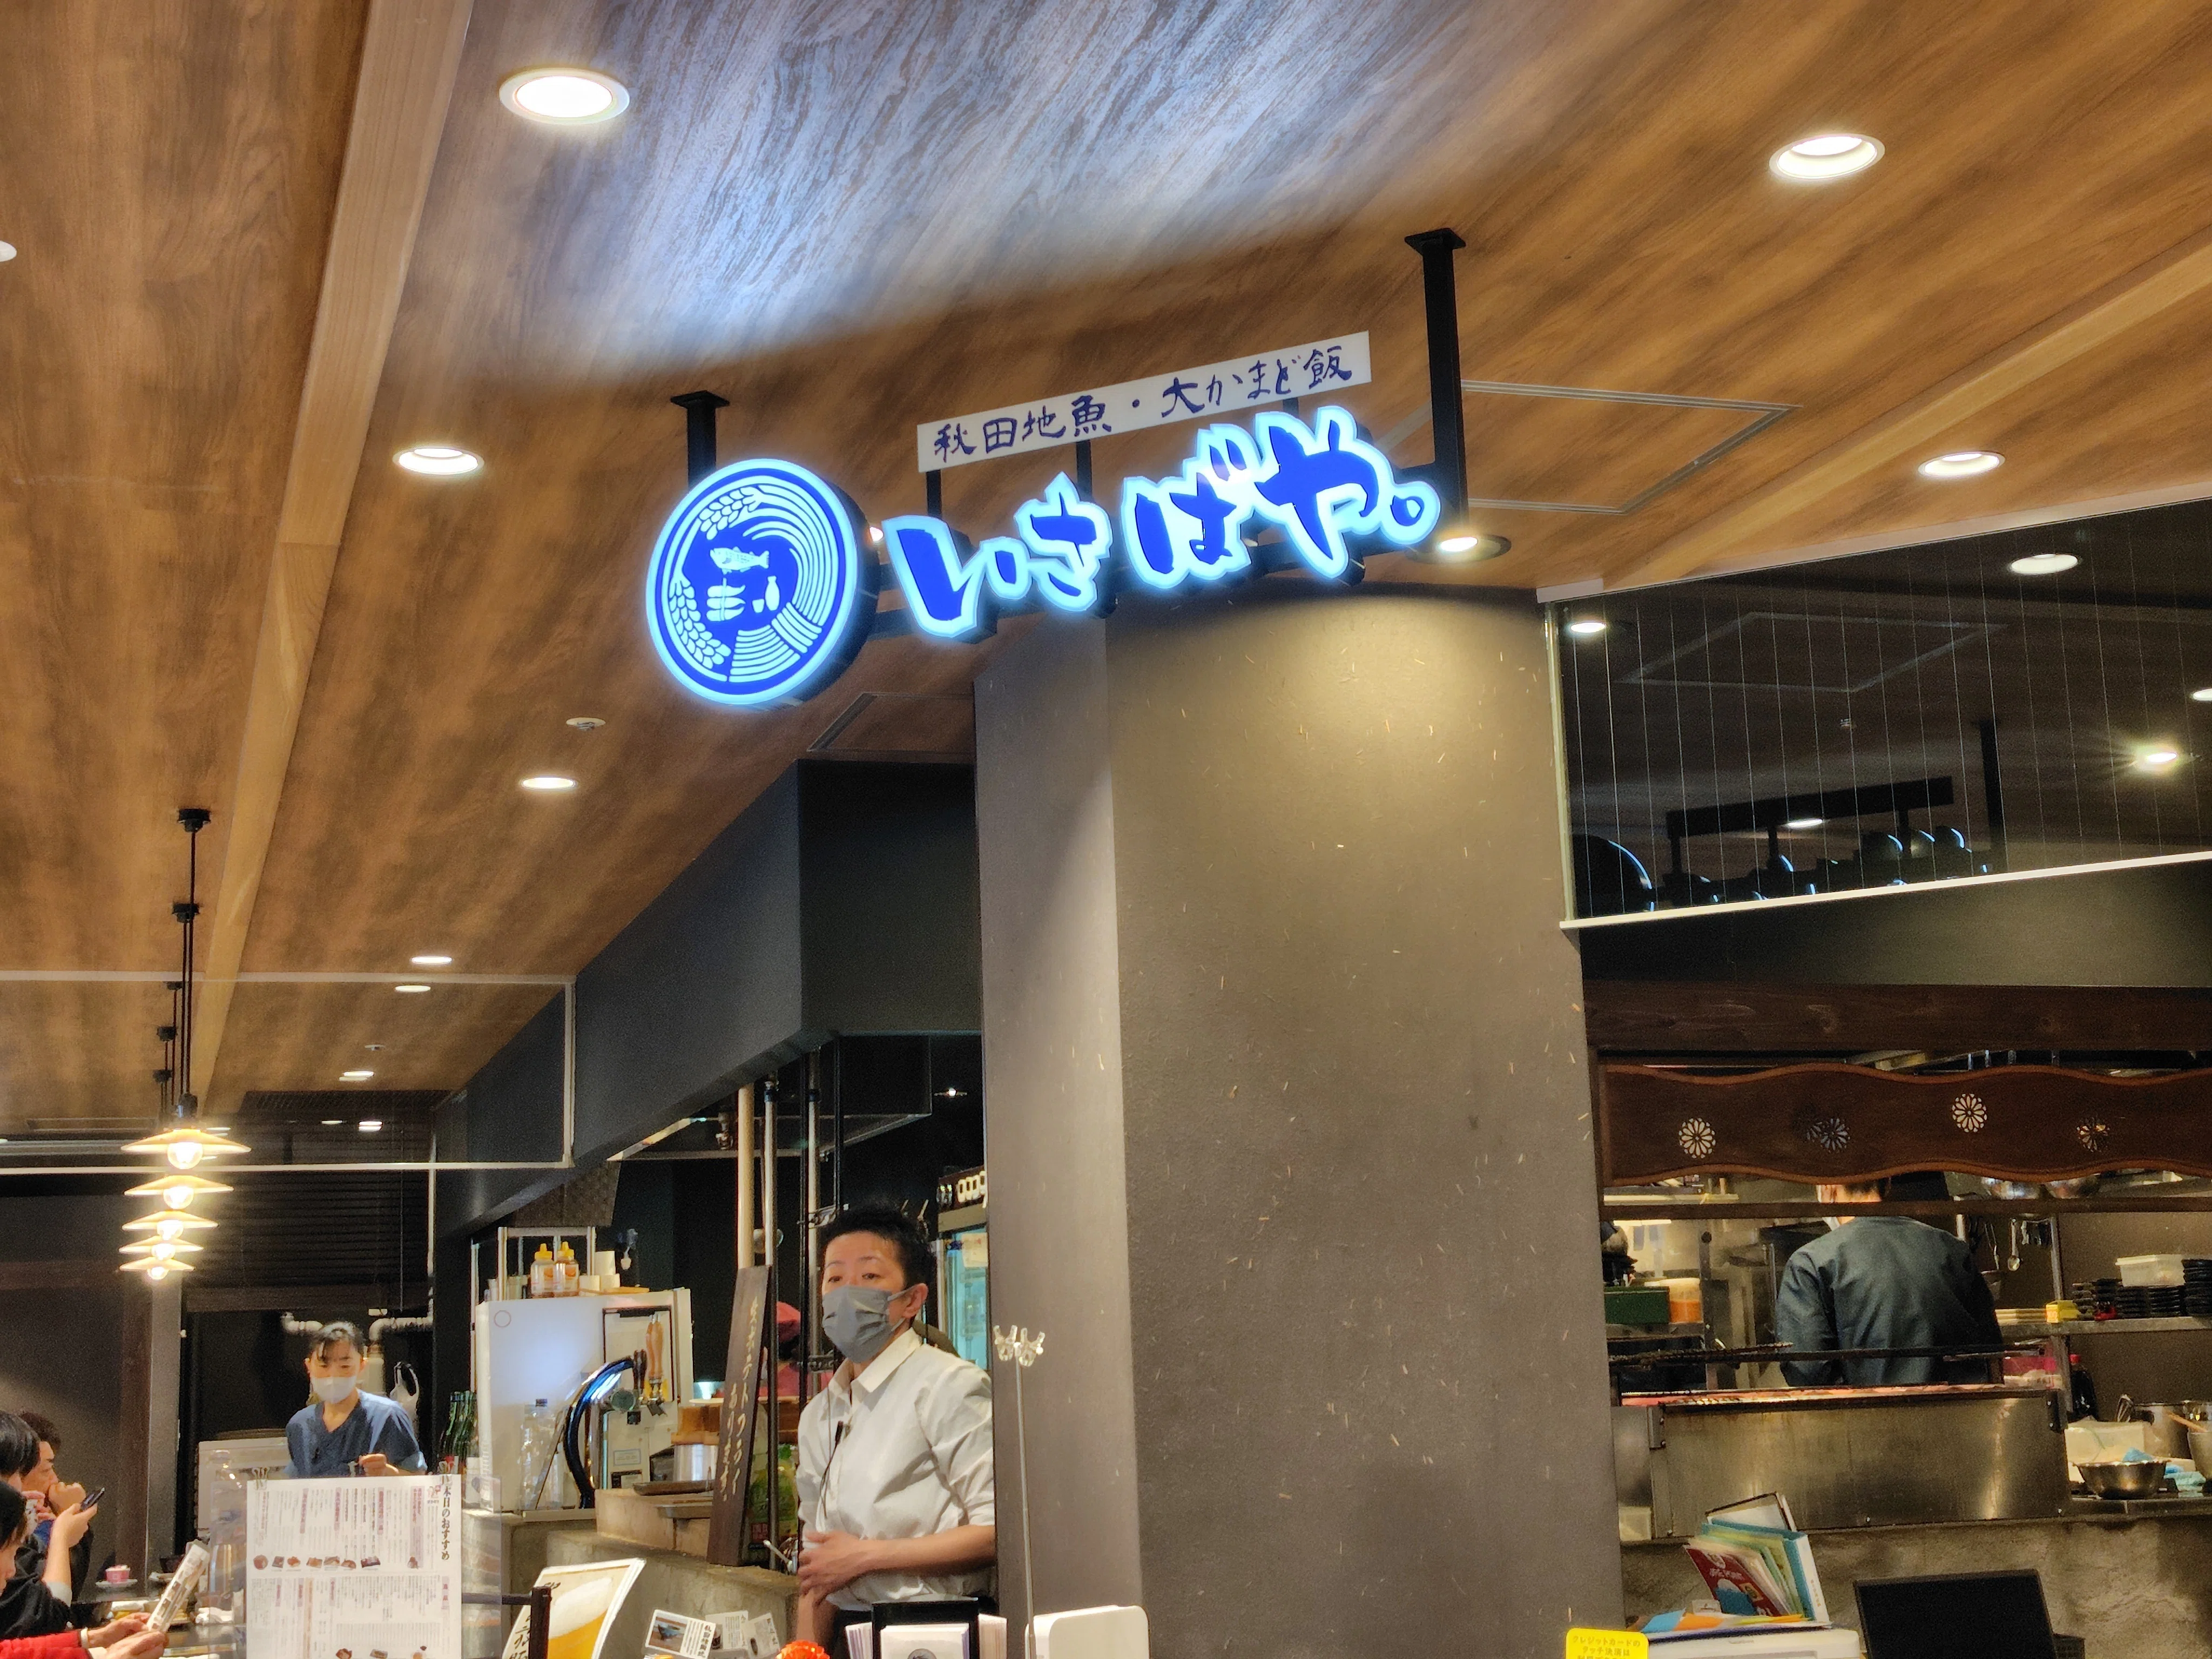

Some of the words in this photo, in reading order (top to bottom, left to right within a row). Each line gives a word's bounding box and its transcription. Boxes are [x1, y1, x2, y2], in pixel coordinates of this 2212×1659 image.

[934, 345, 1352, 463] 秋田地魚・大かまど飯
[441, 1486, 451, 1560] 本日のおすすめ
[1573, 1635, 1641, 1647] クレジットカードの
